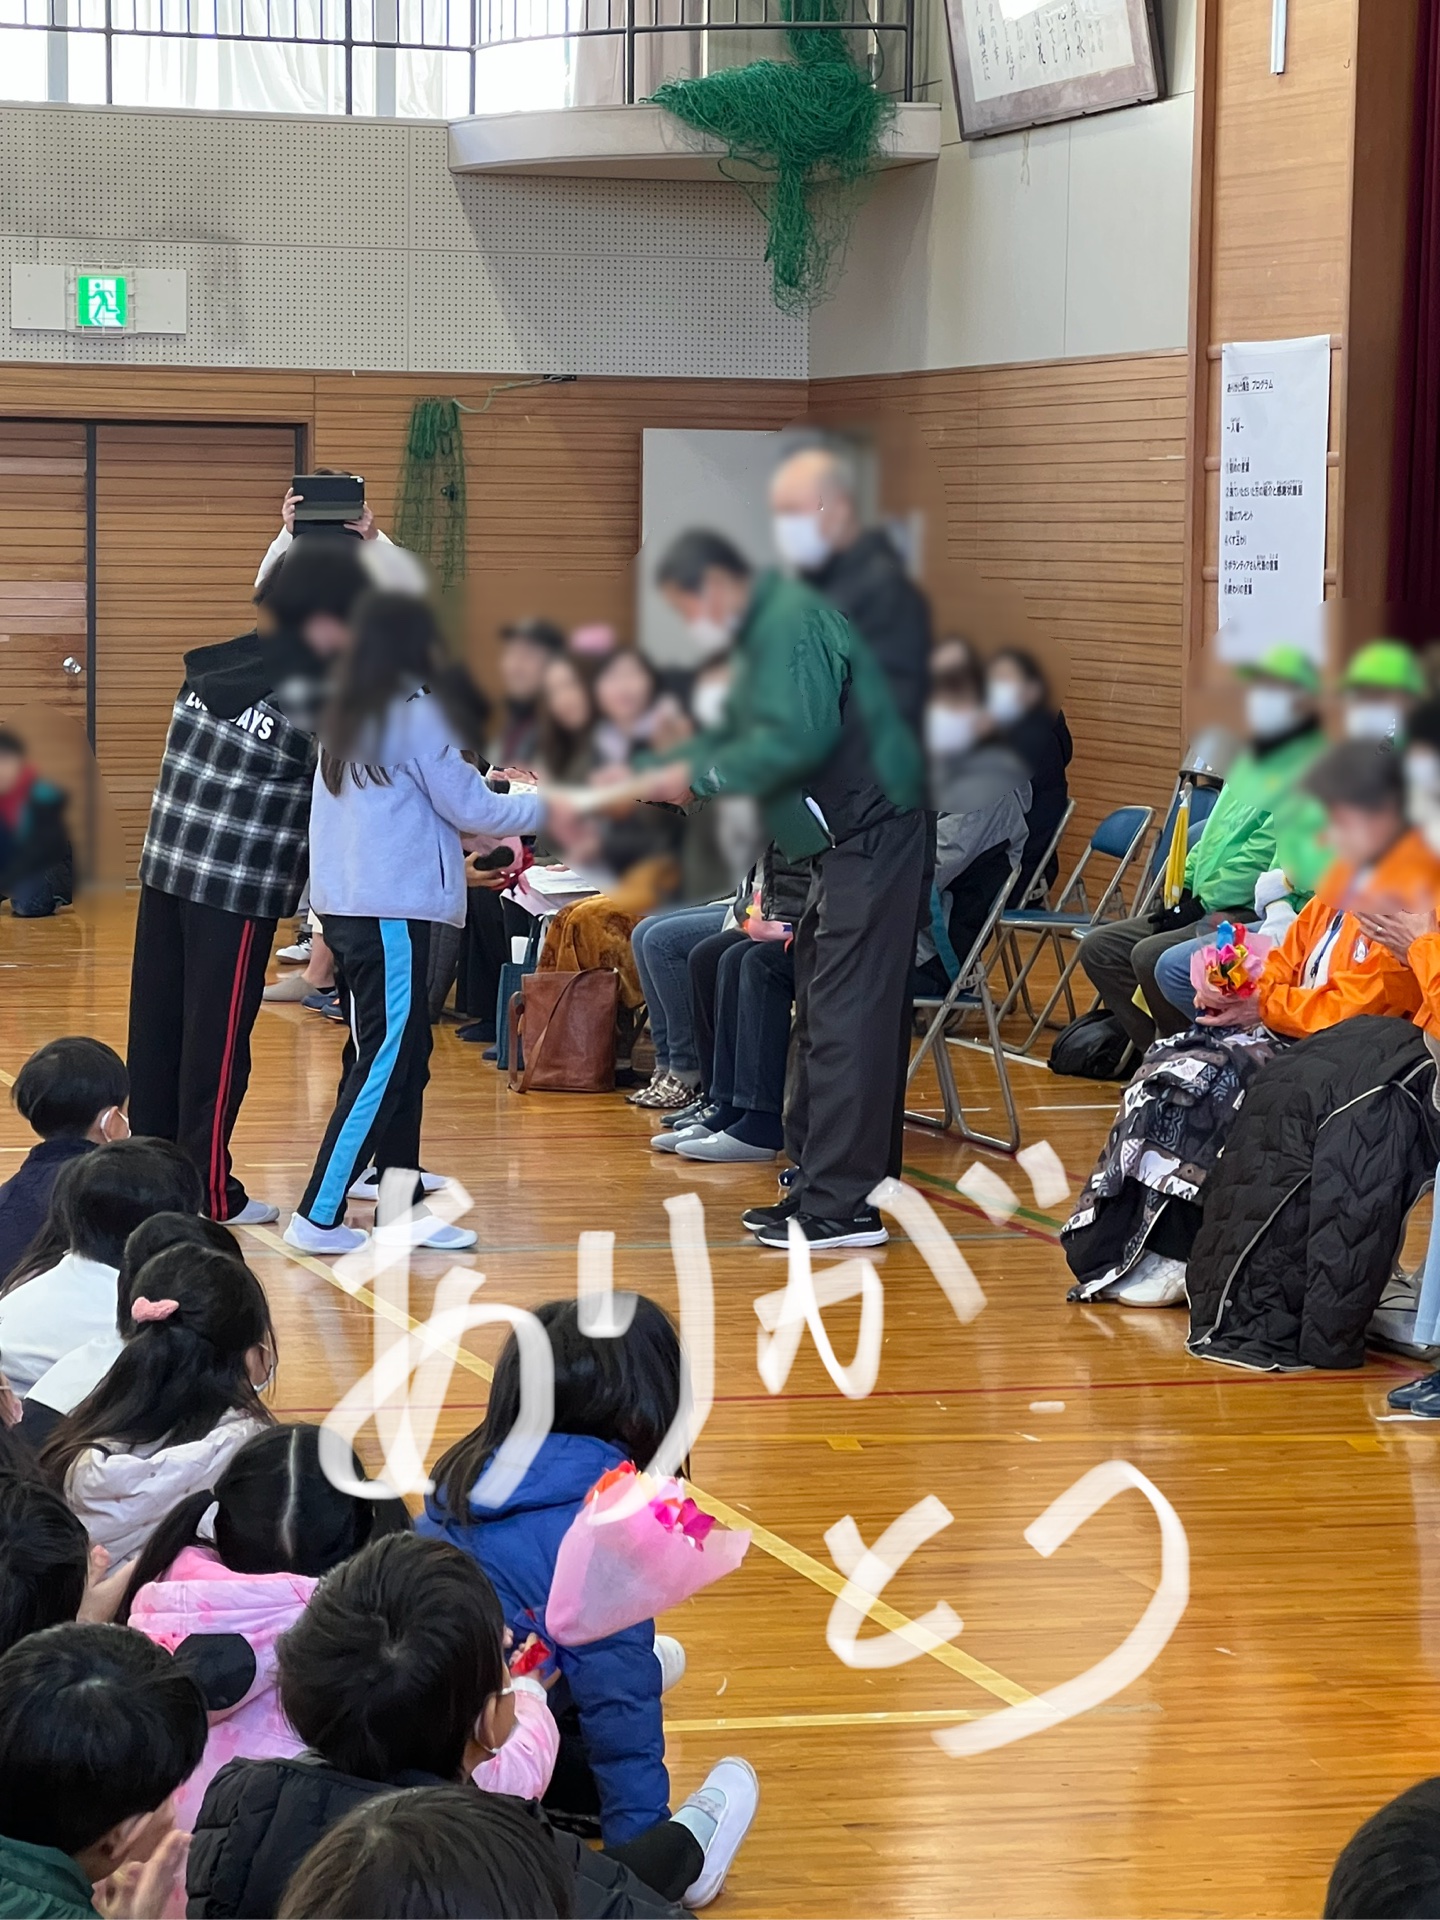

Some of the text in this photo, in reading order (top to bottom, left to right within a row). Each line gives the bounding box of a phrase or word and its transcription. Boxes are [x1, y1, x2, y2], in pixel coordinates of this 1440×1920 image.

[1252, 379, 1274, 391] プログラム
[229, 707, 274, 740] AYS
